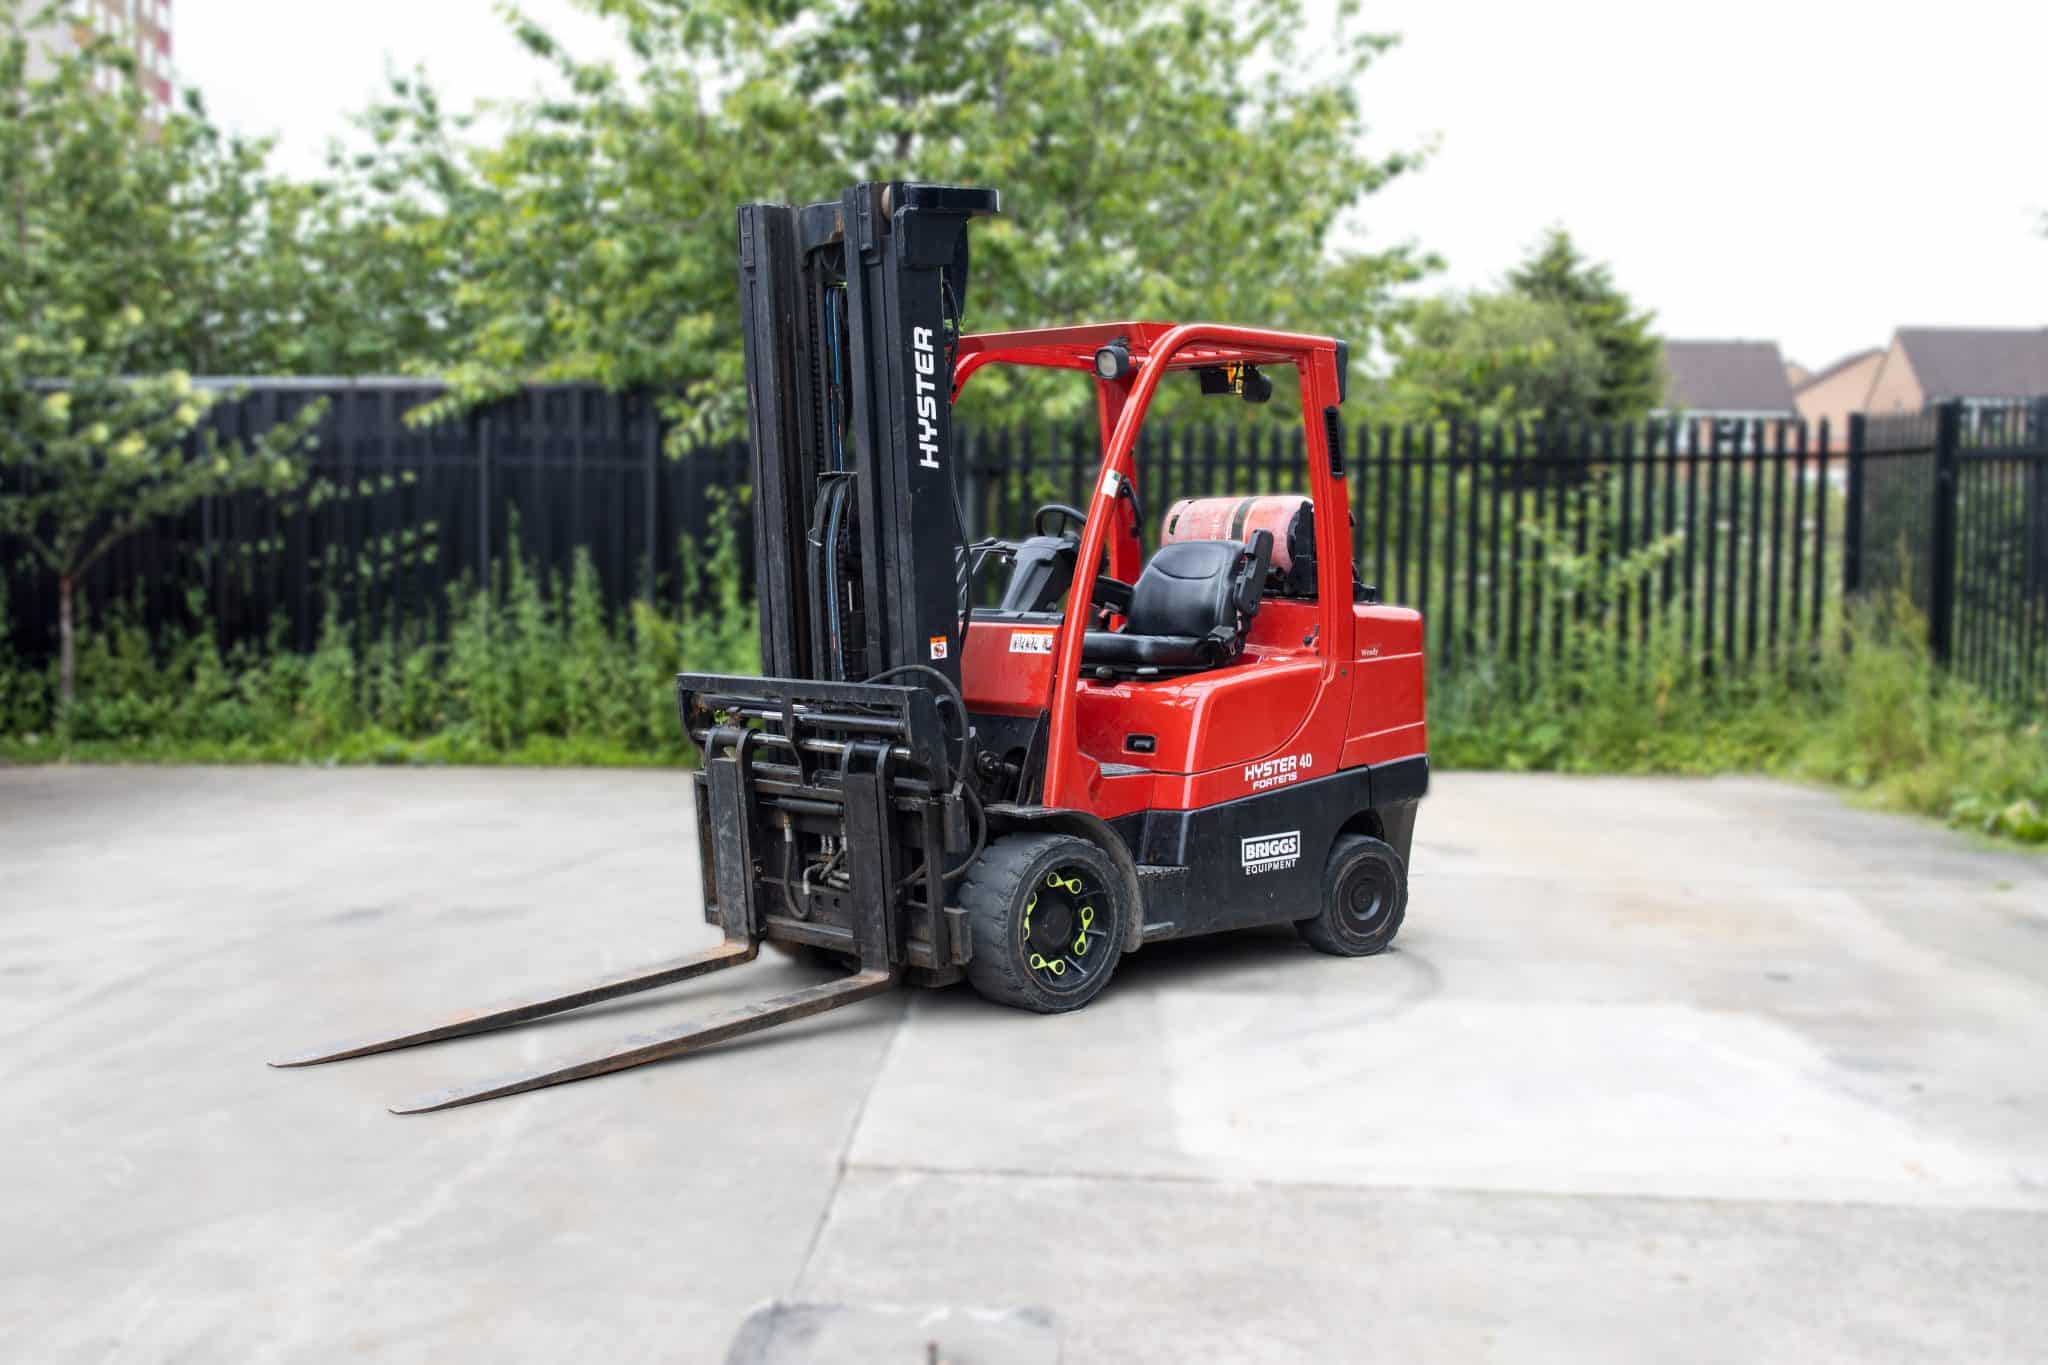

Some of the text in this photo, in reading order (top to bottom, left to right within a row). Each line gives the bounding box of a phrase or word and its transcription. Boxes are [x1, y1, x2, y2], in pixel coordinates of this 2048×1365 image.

[913, 326, 940, 470] HYSTER
[1244, 753, 1313, 781] HYSTER 40
[1252, 771, 1298, 790] FORTENS
[1245, 838, 1297, 860] BRIGGS
[1245, 858, 1297, 875] EQUIPMENT
